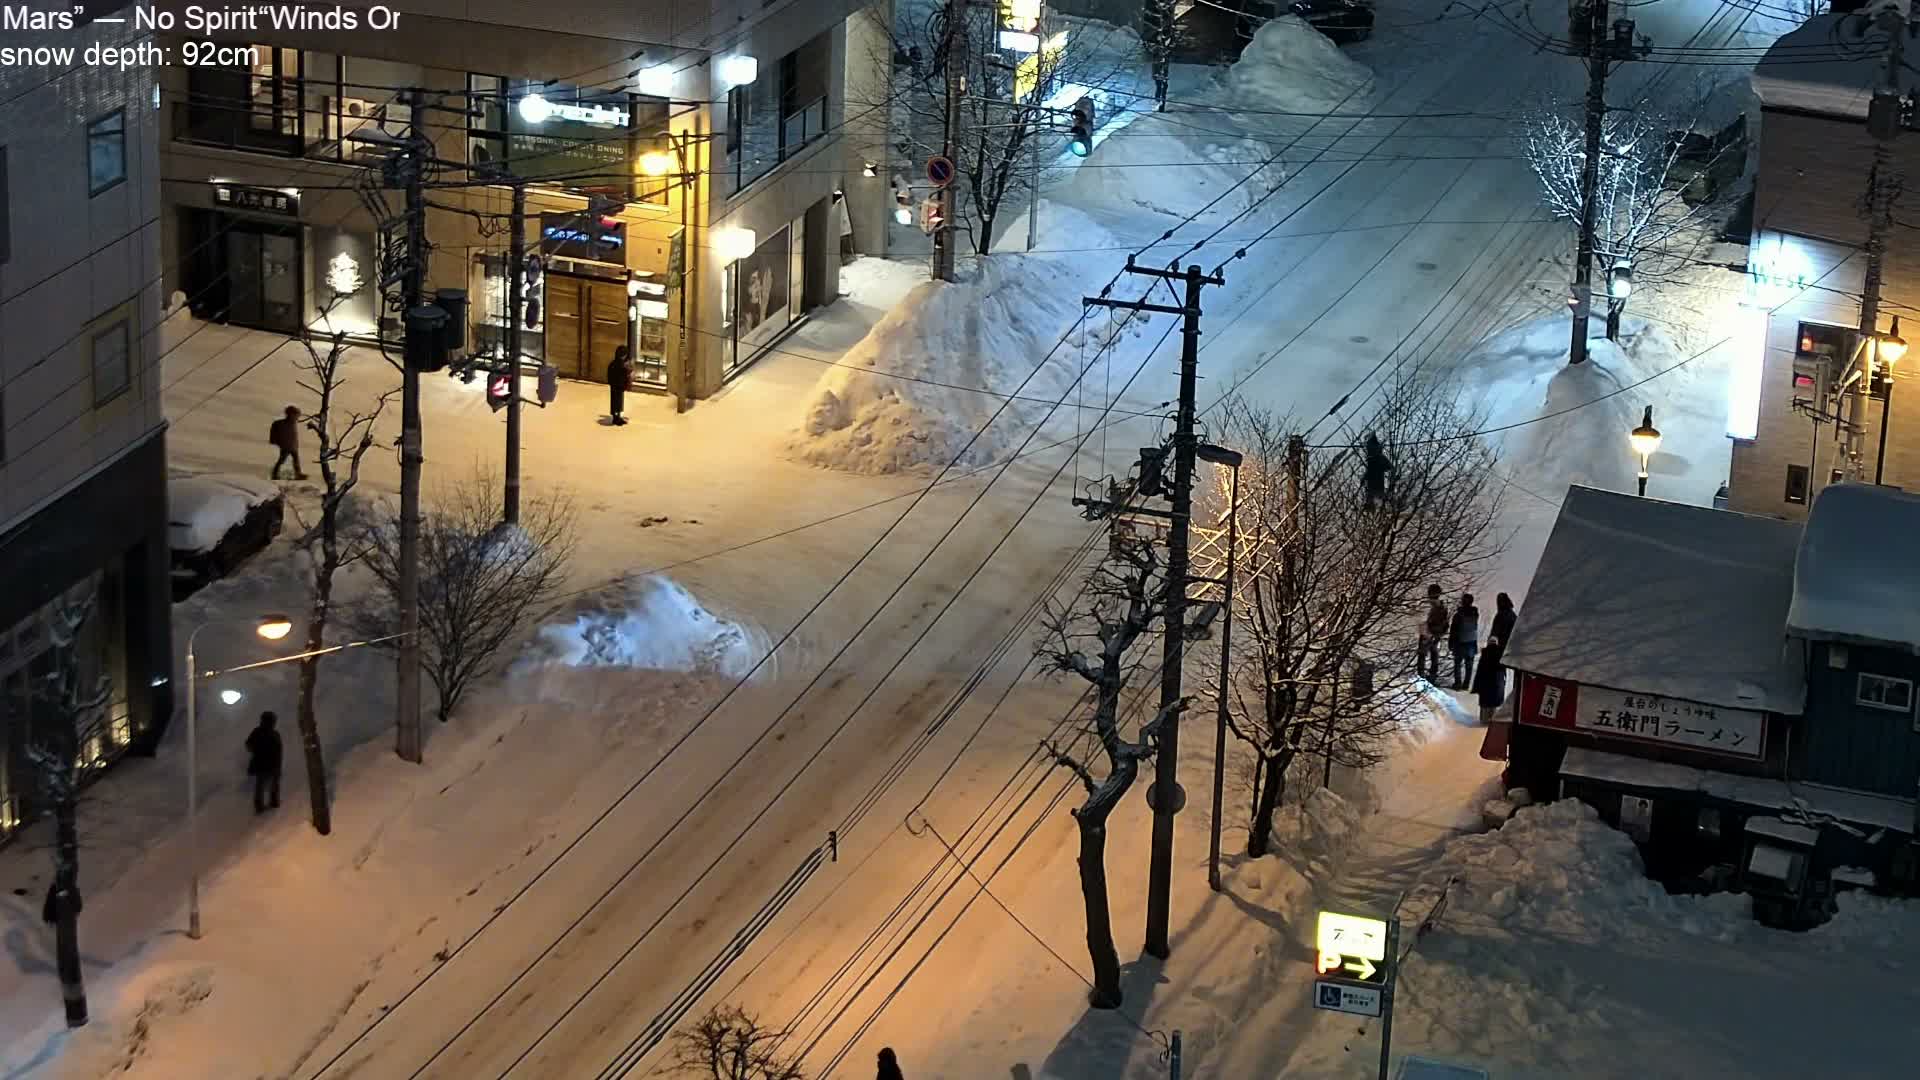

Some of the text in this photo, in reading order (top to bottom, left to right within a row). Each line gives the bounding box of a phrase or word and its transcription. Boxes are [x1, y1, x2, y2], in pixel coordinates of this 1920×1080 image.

[1594, 710, 1748, 747] 五衛門ラーメン
[1317, 951, 1342, 974] P
